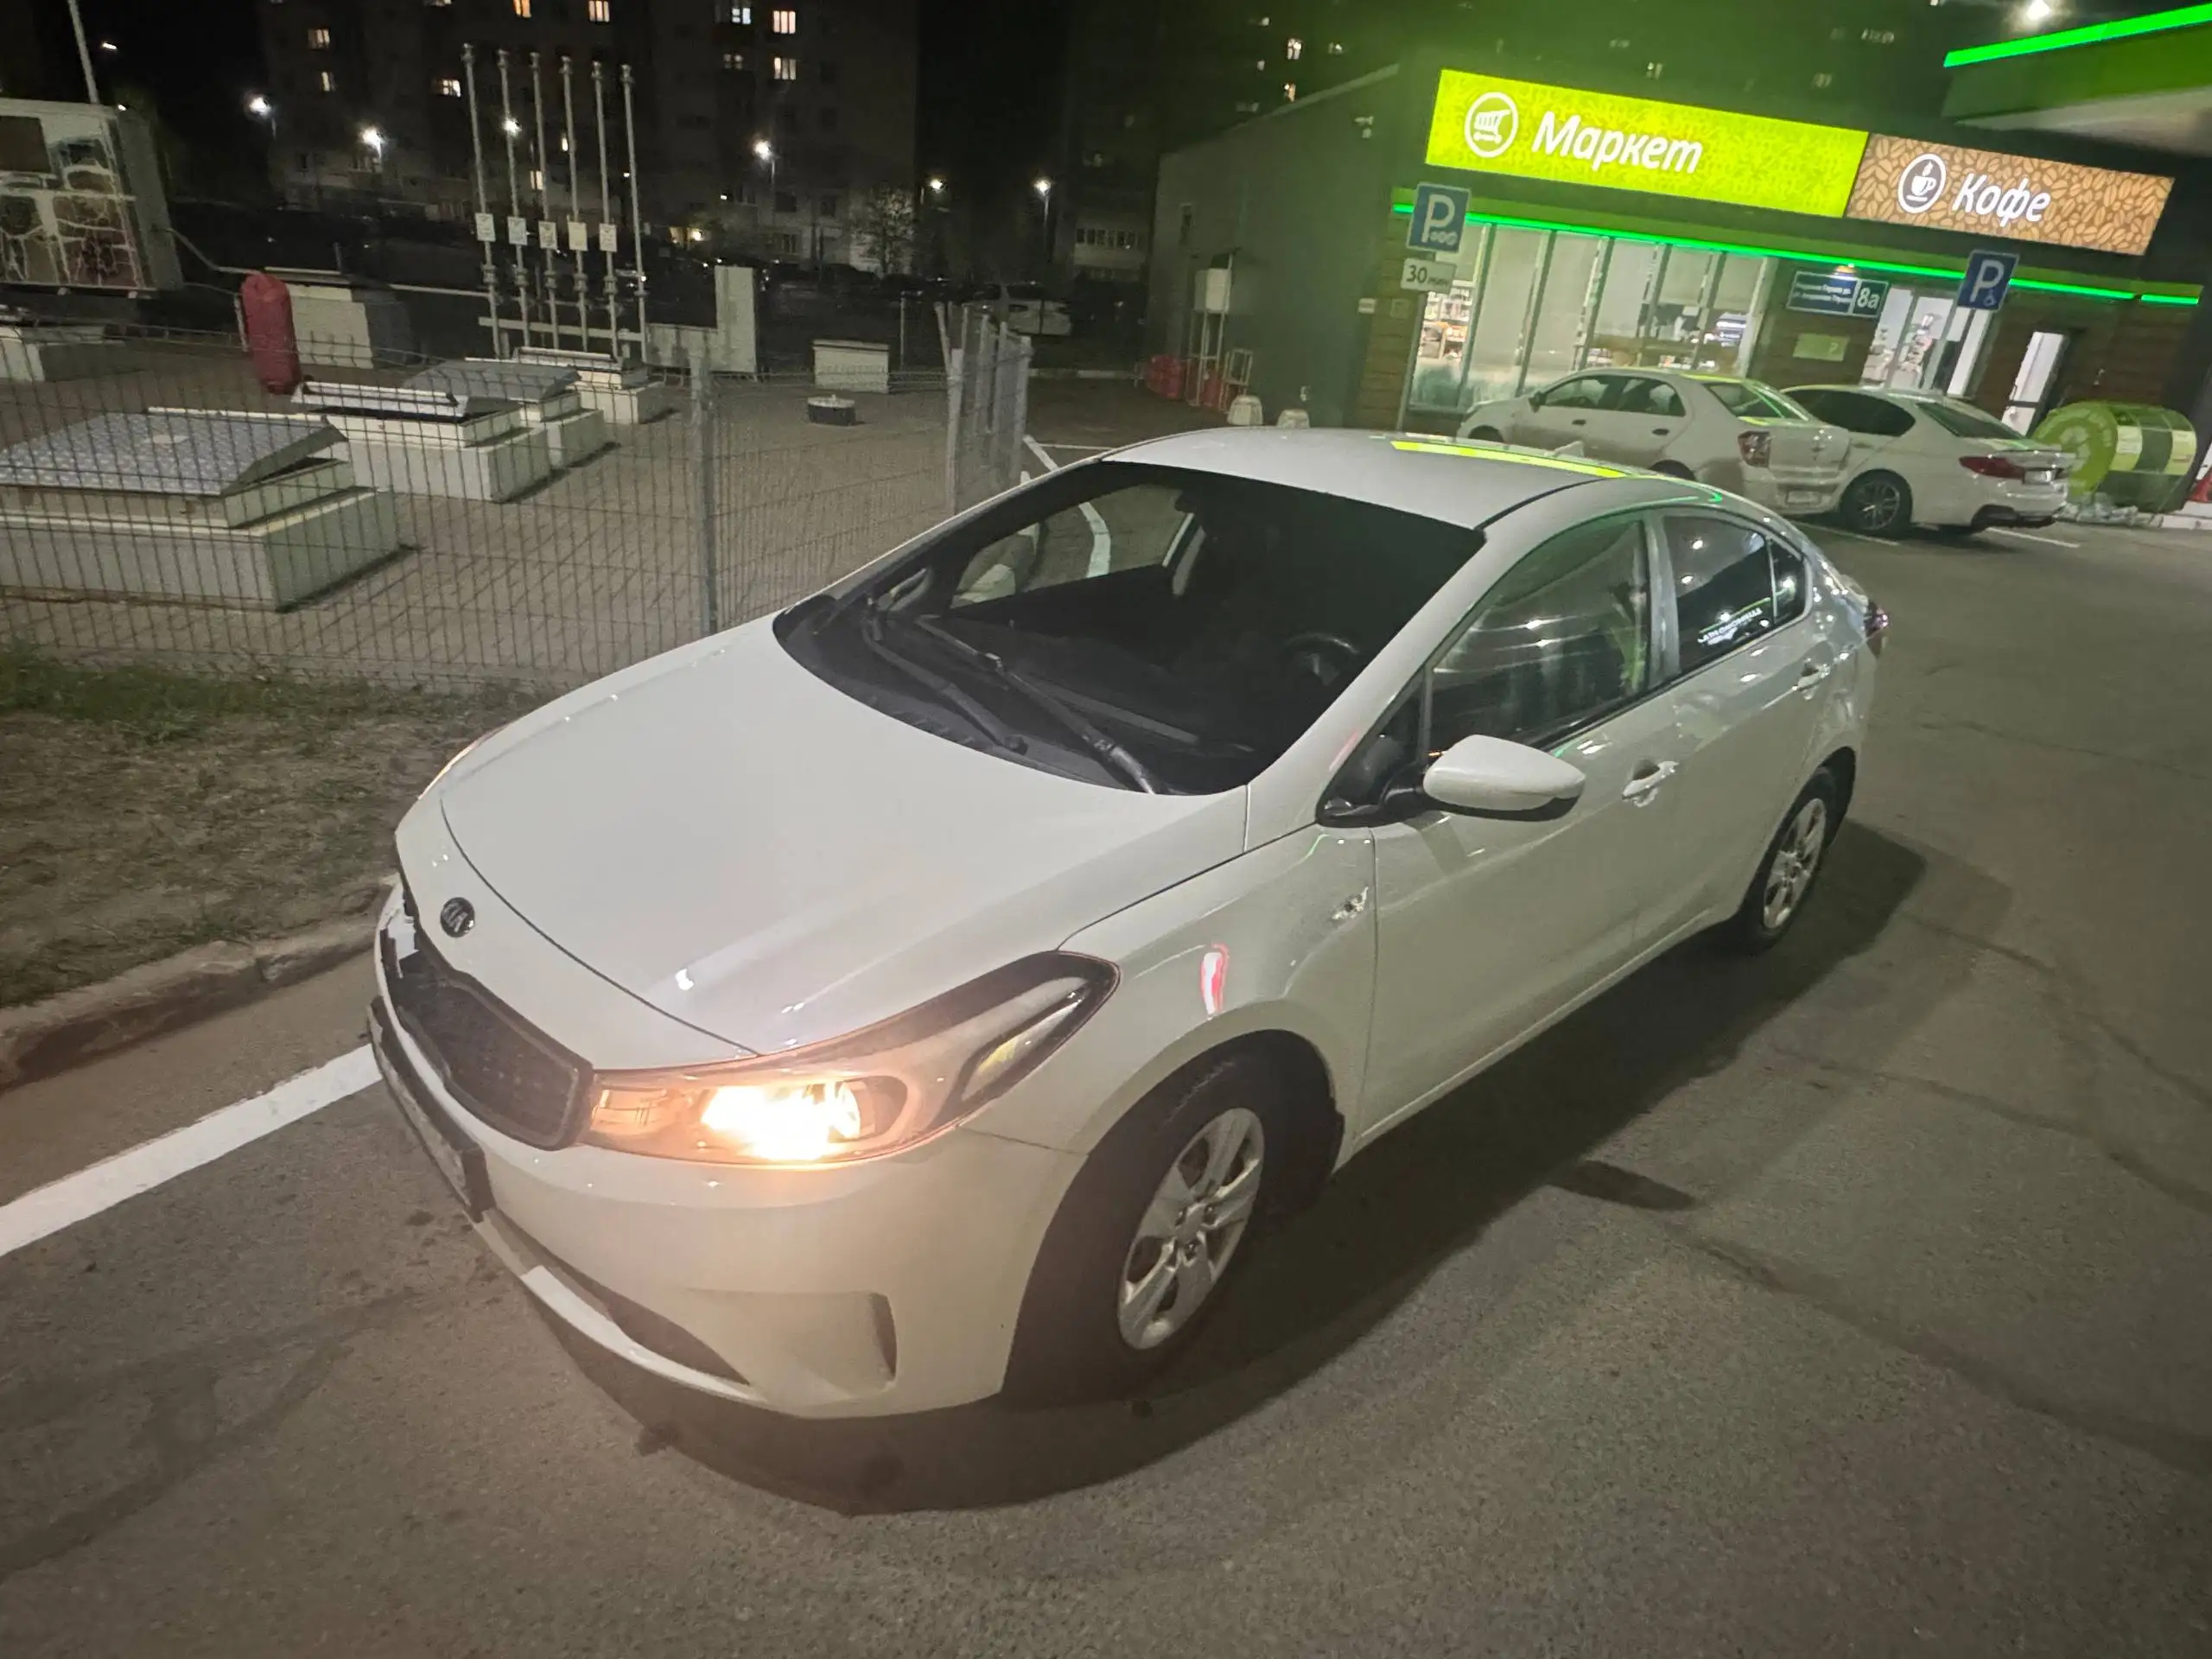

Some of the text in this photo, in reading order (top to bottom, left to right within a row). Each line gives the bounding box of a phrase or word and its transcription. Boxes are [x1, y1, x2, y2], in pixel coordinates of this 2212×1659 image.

[1531, 111, 1703, 174] Маркет
[1952, 173, 2051, 227] Кофе
[1406, 264, 1427, 283] 30
